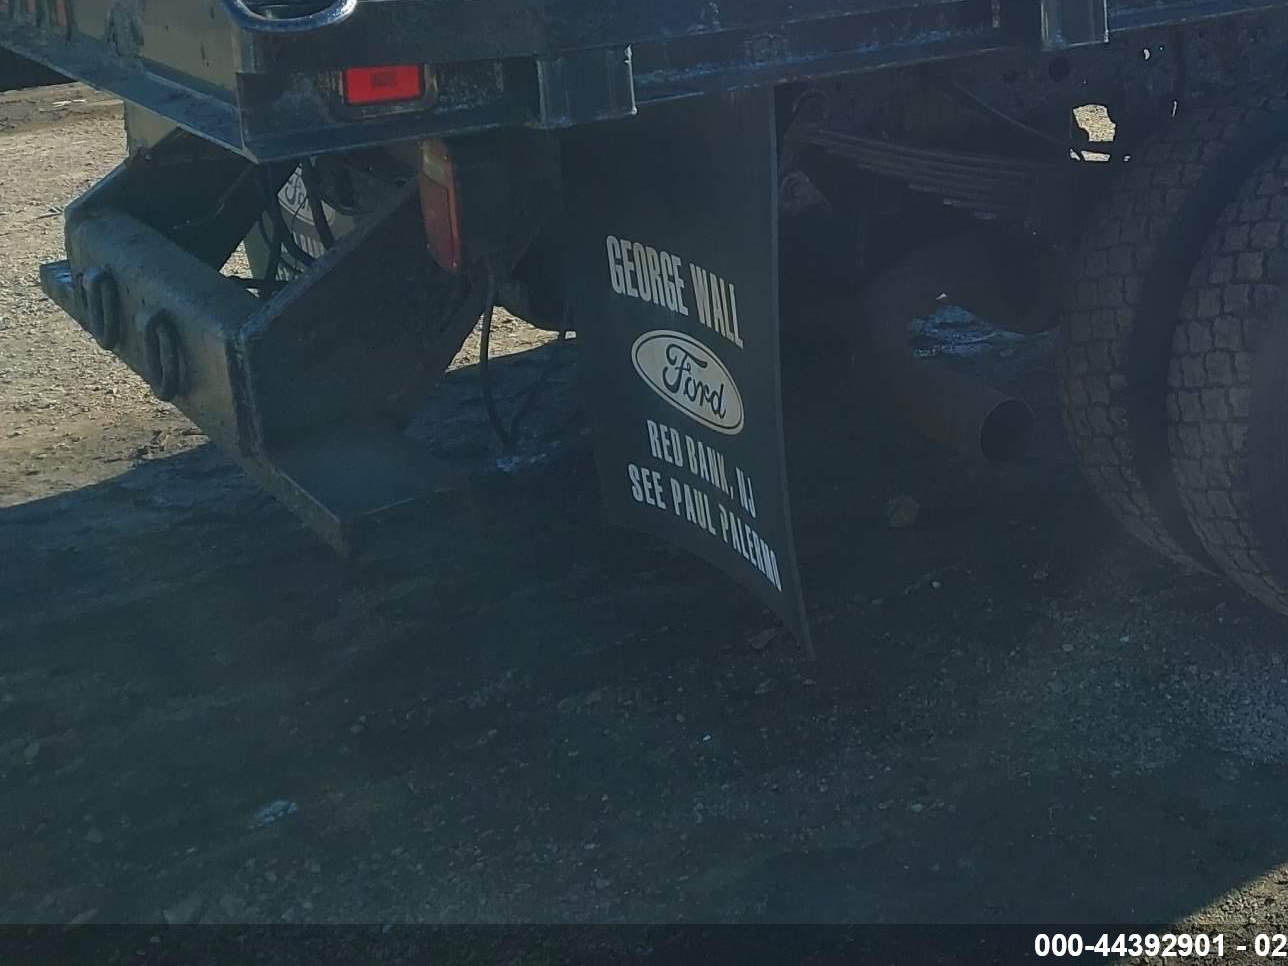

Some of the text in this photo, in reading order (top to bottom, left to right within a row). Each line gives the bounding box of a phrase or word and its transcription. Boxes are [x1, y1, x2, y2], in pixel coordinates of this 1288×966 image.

[606, 234, 744, 349] GEORGE WALL
[662, 343, 727, 419] Ford
[646, 419, 756, 519] RED BANK, NJ
[627, 463, 783, 592] SEE PAUL PALERMO
